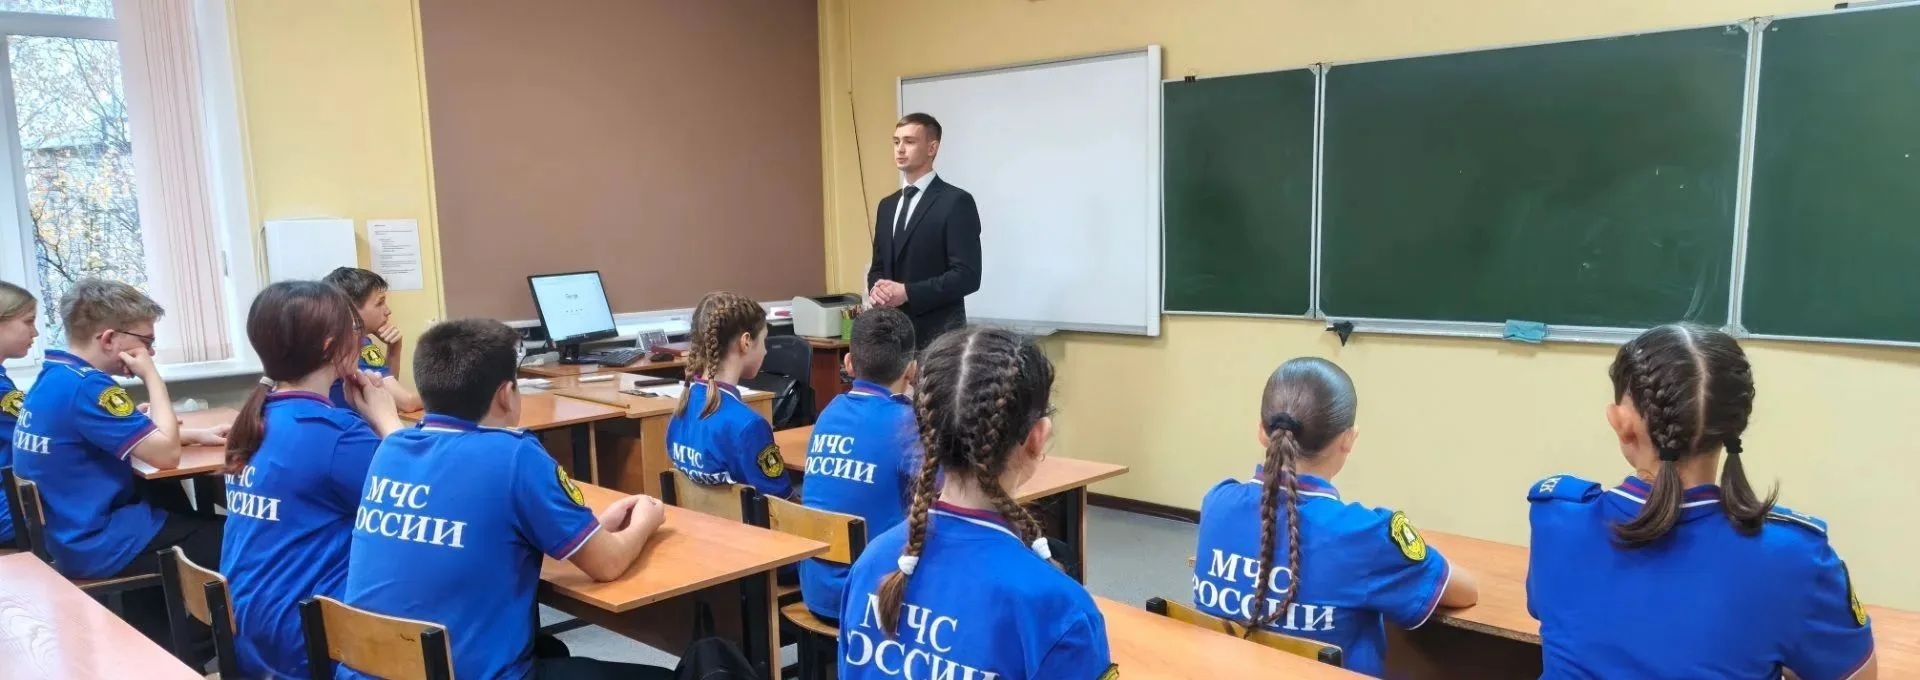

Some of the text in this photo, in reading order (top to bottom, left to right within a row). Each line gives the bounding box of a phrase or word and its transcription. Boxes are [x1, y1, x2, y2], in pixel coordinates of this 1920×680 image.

[673, 442, 704, 469] МЧС
[811, 434, 855, 455] МЧС
[805, 456, 877, 484] ОССИИ
[365, 475, 430, 509] МЧС
[355, 505, 468, 548] ОССИИ
[1208, 549, 1292, 594] МЧС
